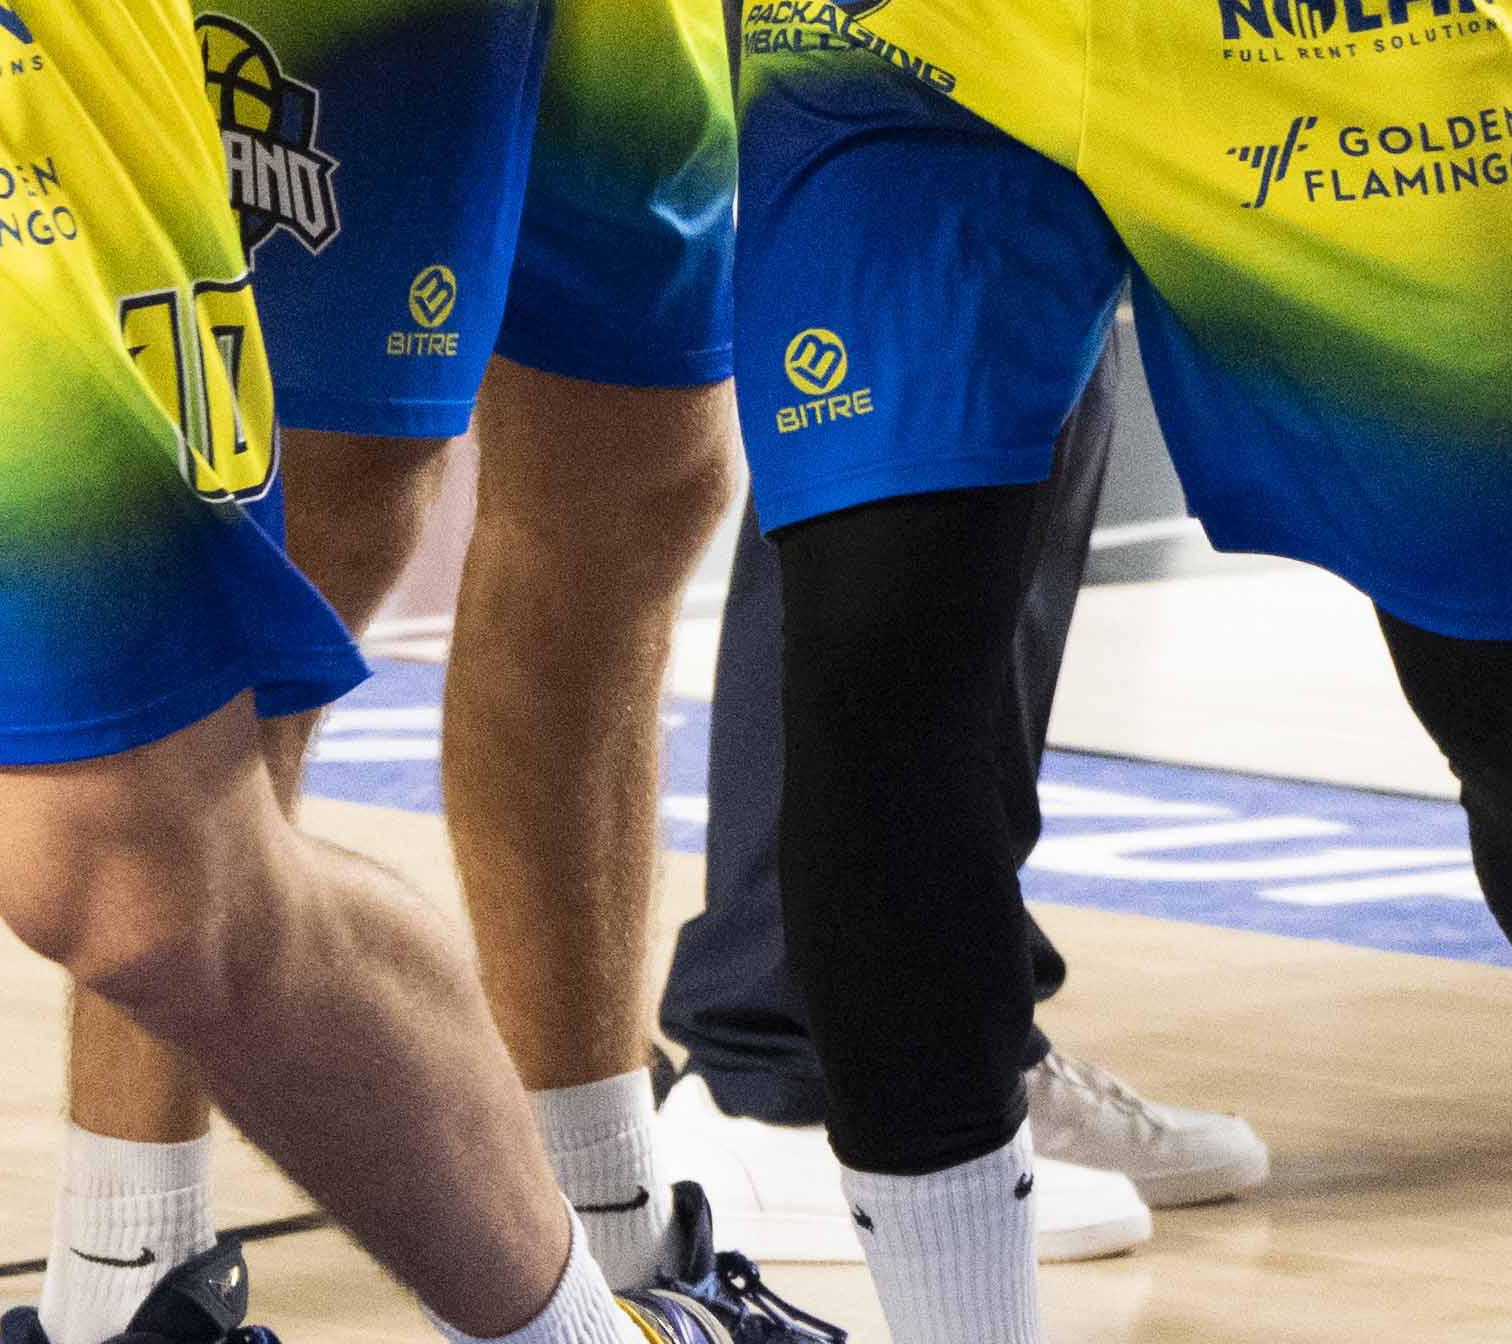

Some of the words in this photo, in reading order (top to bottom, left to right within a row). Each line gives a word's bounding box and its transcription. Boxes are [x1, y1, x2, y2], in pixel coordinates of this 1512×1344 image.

[1223, 46, 1284, 63] FULL
[1299, 43, 1357, 60] RENT
[1374, 18, 1498, 53] SOLUTION
[387, 331, 459, 358] BITRE
[775, 387, 874, 434] BITRE
